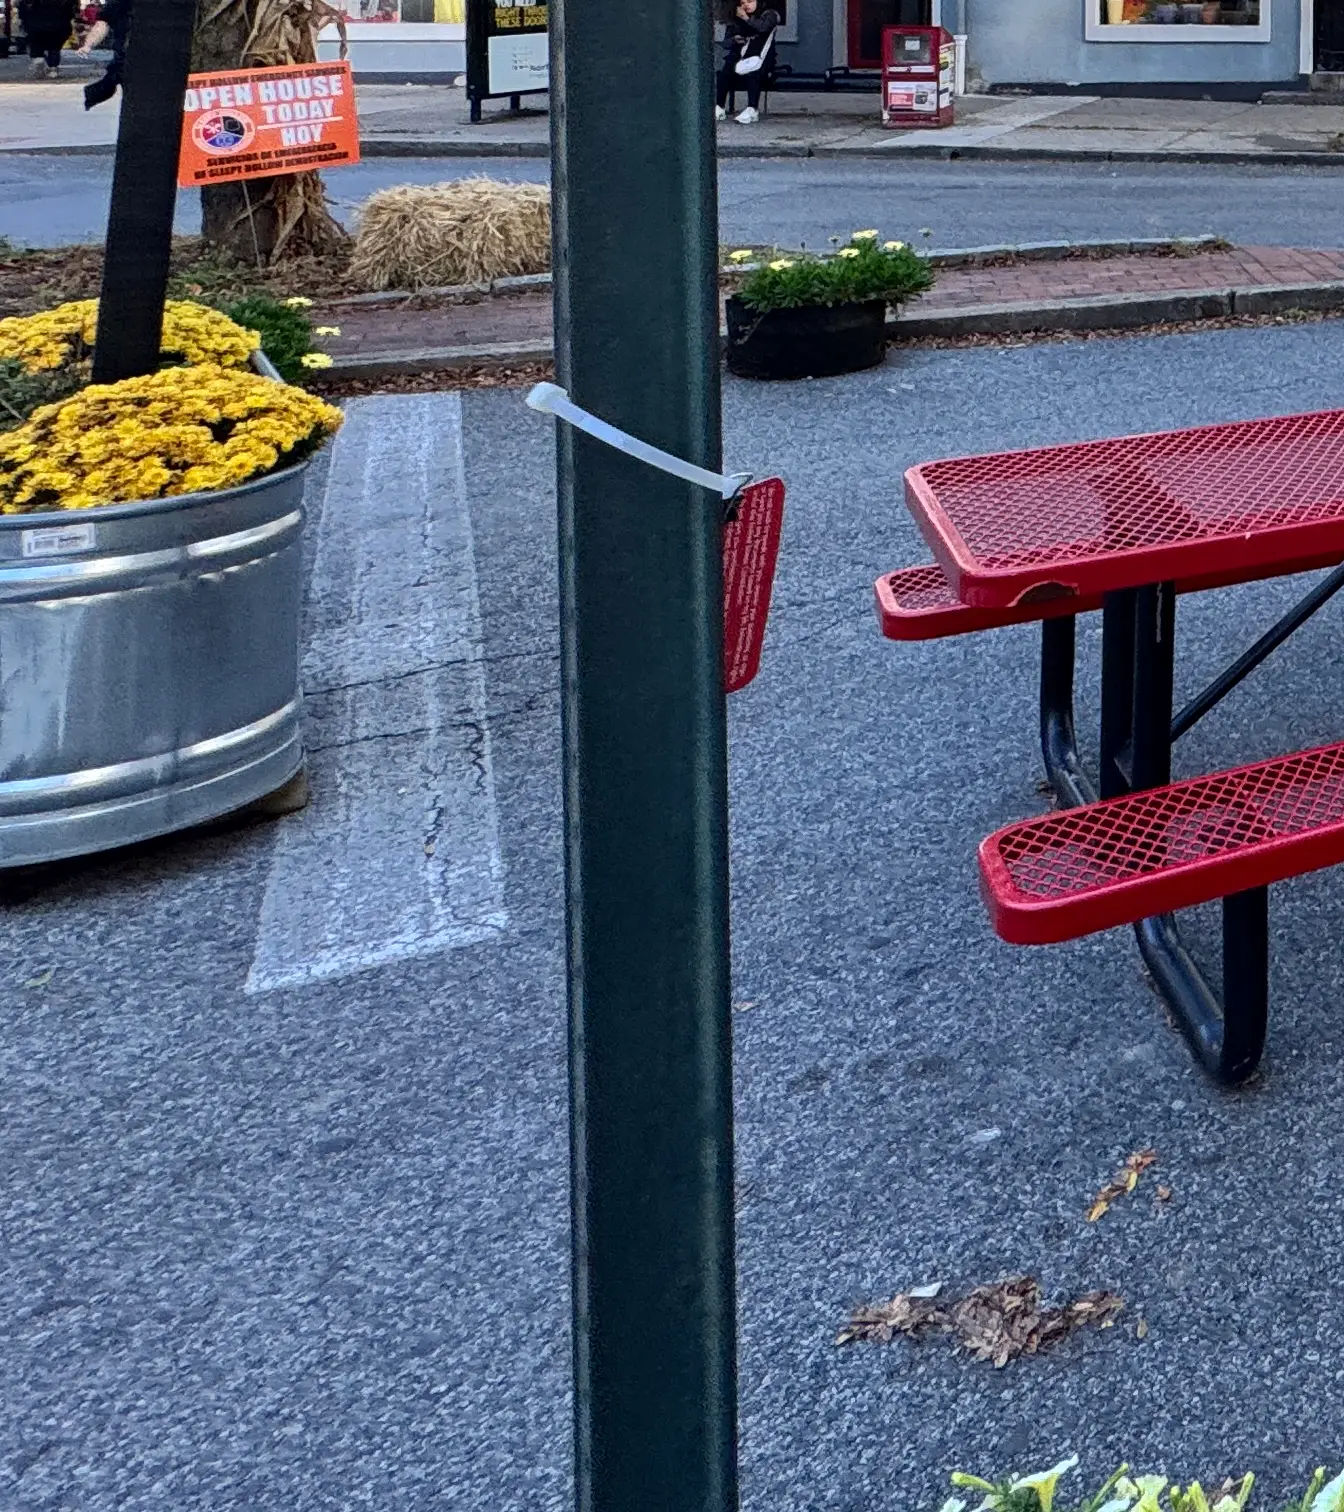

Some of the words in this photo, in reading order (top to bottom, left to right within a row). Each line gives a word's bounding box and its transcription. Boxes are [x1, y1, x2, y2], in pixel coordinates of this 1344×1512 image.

[183, 83, 254, 111] OPEN
[257, 75, 344, 103] HOUSE
[260, 99, 334, 124] TODAY
[280, 124, 323, 147] HOY
